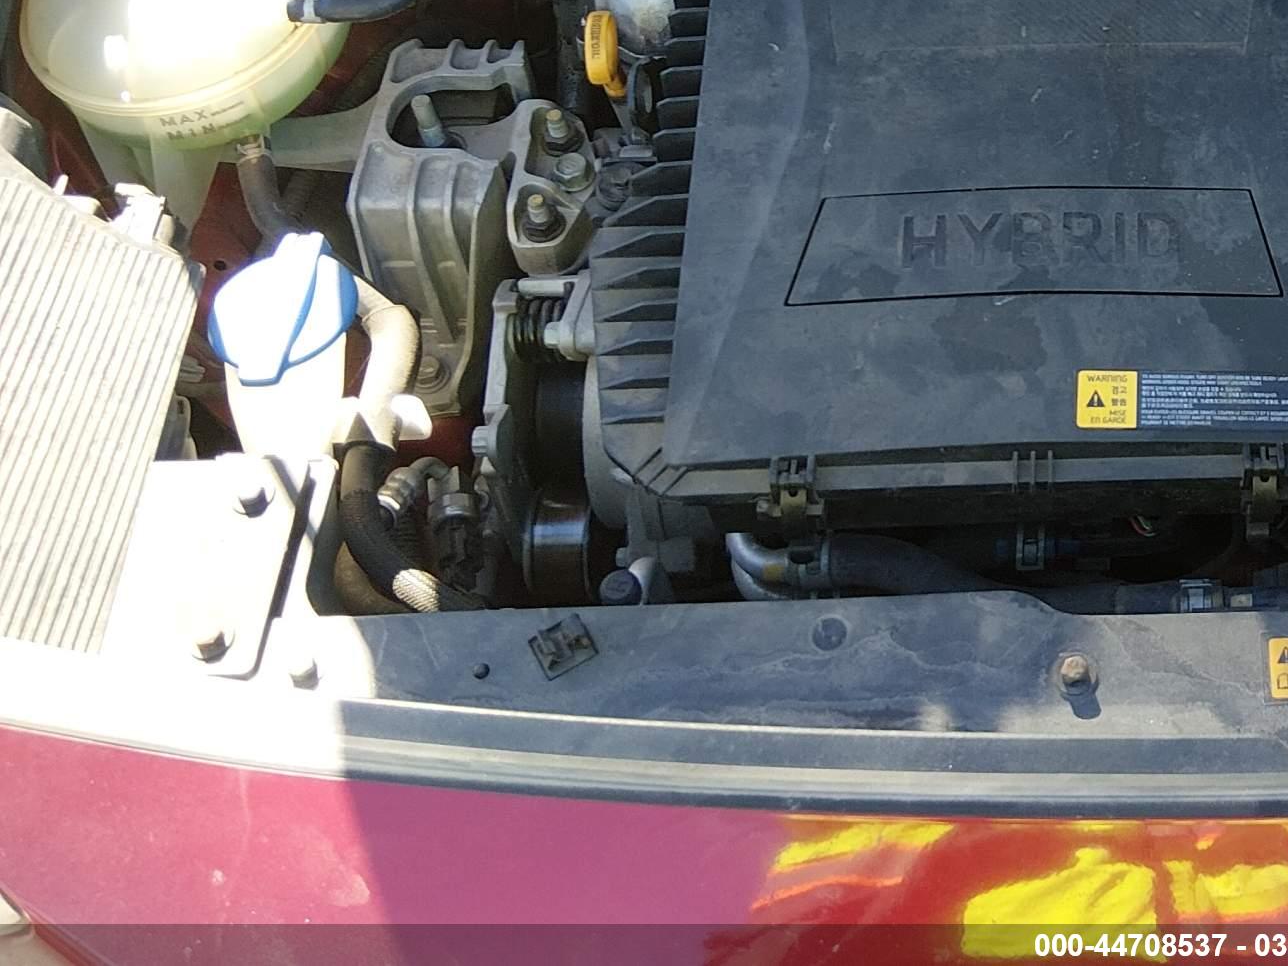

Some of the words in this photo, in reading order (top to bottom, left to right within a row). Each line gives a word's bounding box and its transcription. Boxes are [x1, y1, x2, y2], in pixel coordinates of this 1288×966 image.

[159, 109, 209, 127] MAX
[166, 123, 217, 141] MIN
[901, 210, 1184, 268] HYBRID
[1087, 374, 1128, 383] WARNING
